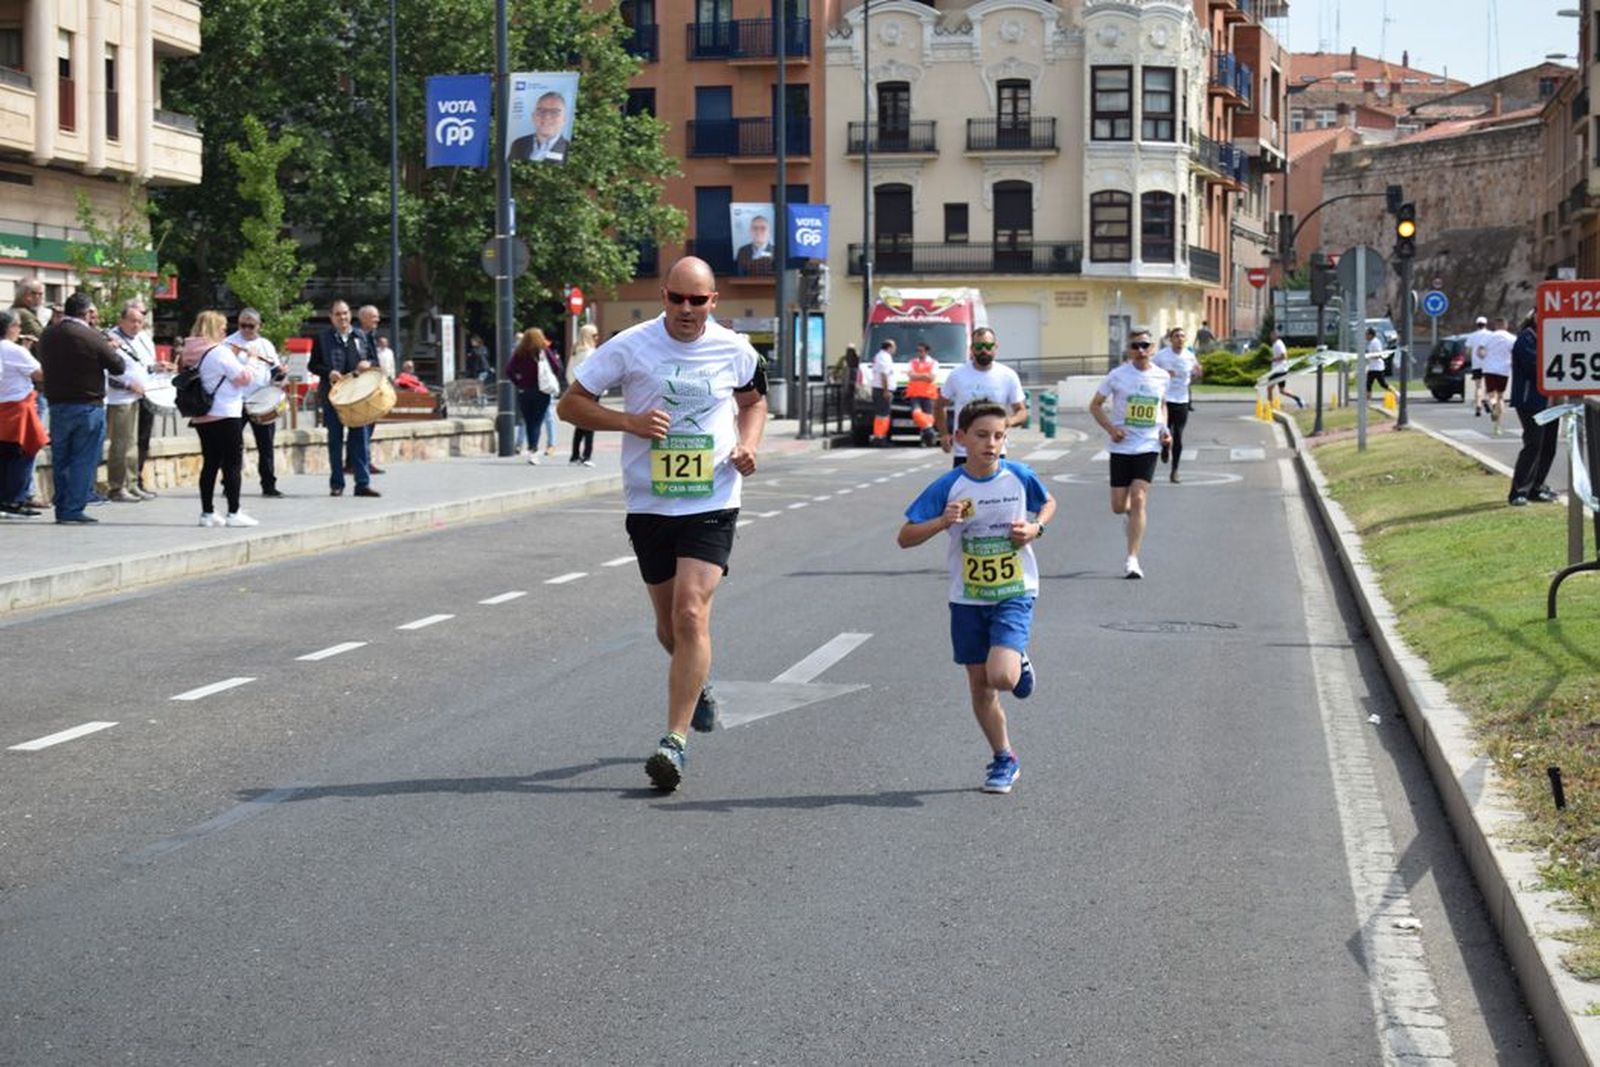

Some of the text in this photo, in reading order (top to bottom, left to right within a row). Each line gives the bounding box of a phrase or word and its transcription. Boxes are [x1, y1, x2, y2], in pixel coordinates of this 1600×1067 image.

[438, 100, 477, 113] VOTA
[795, 217, 822, 227] VOTA
[1561, 326, 1591, 342] km
[1546, 352, 1600, 382] 459
[1131, 405, 1154, 419] 100
[660, 453, 702, 478] 121
[967, 556, 1015, 583] 255
